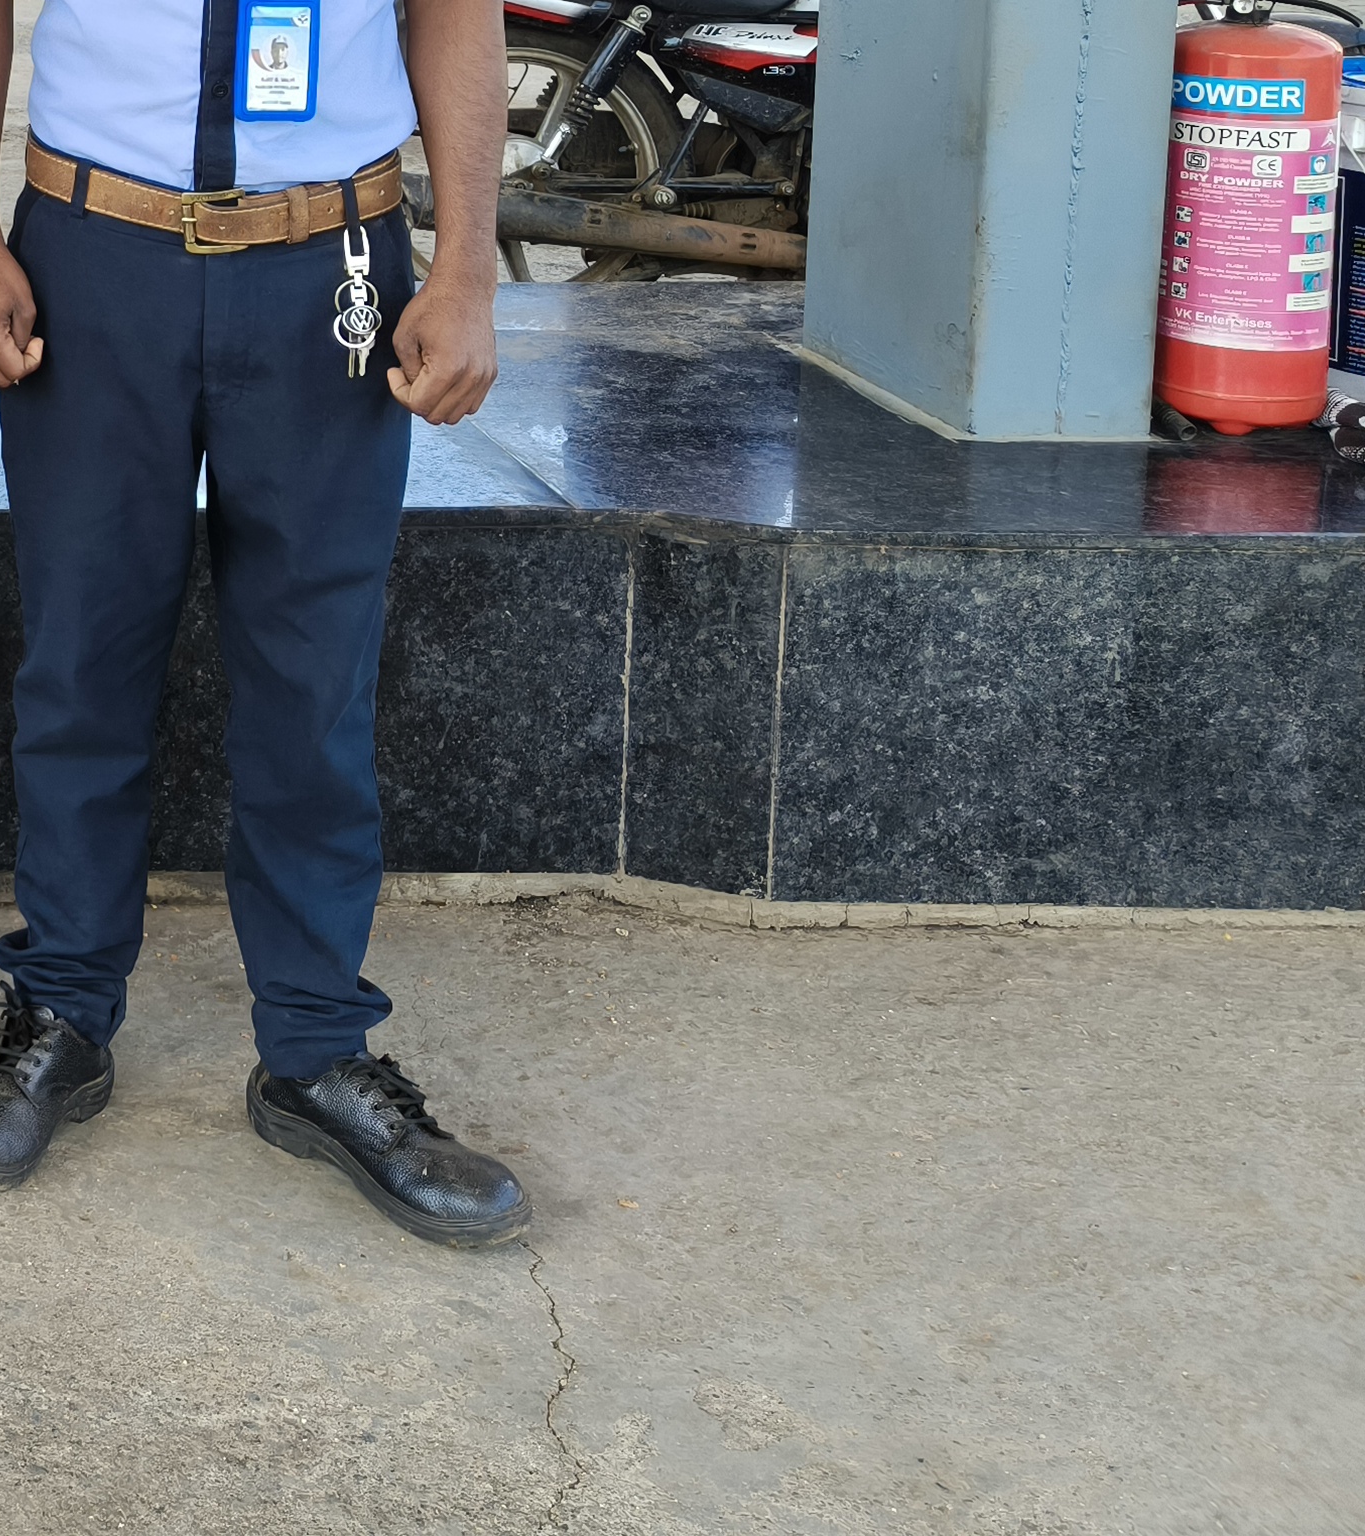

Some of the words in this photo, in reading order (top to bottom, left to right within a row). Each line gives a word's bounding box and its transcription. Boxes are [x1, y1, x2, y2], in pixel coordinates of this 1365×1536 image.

[1172, 79, 1301, 108] POWDER
[1174, 122, 1297, 149] STOPFAST
[1180, 171, 1209, 183] DRY
[1213, 175, 1284, 188] POWDER
[1175, 307, 1192, 319] VK
